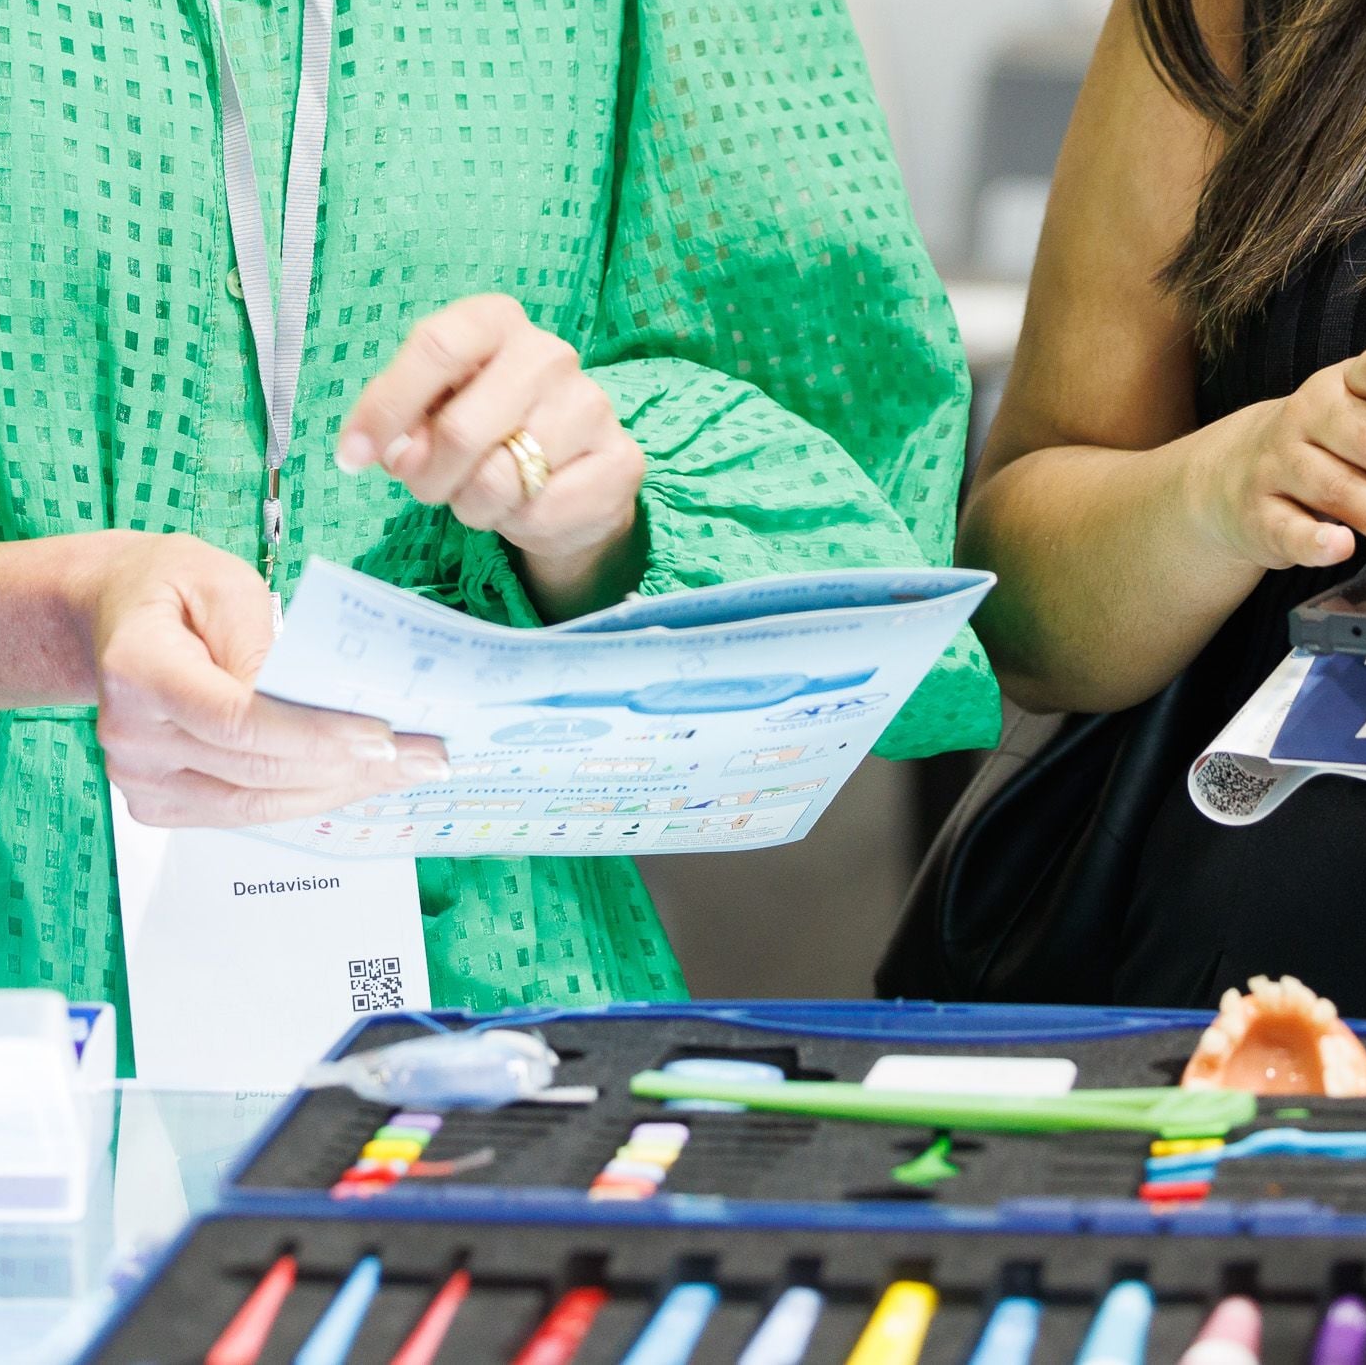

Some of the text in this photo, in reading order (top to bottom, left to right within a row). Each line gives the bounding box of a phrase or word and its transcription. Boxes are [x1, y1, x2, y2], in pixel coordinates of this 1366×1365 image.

[402, 787, 456, 799] your
[466, 786, 609, 795] interdental
[616, 783, 688, 794] brush
[233, 875, 341, 897] Dentavision
